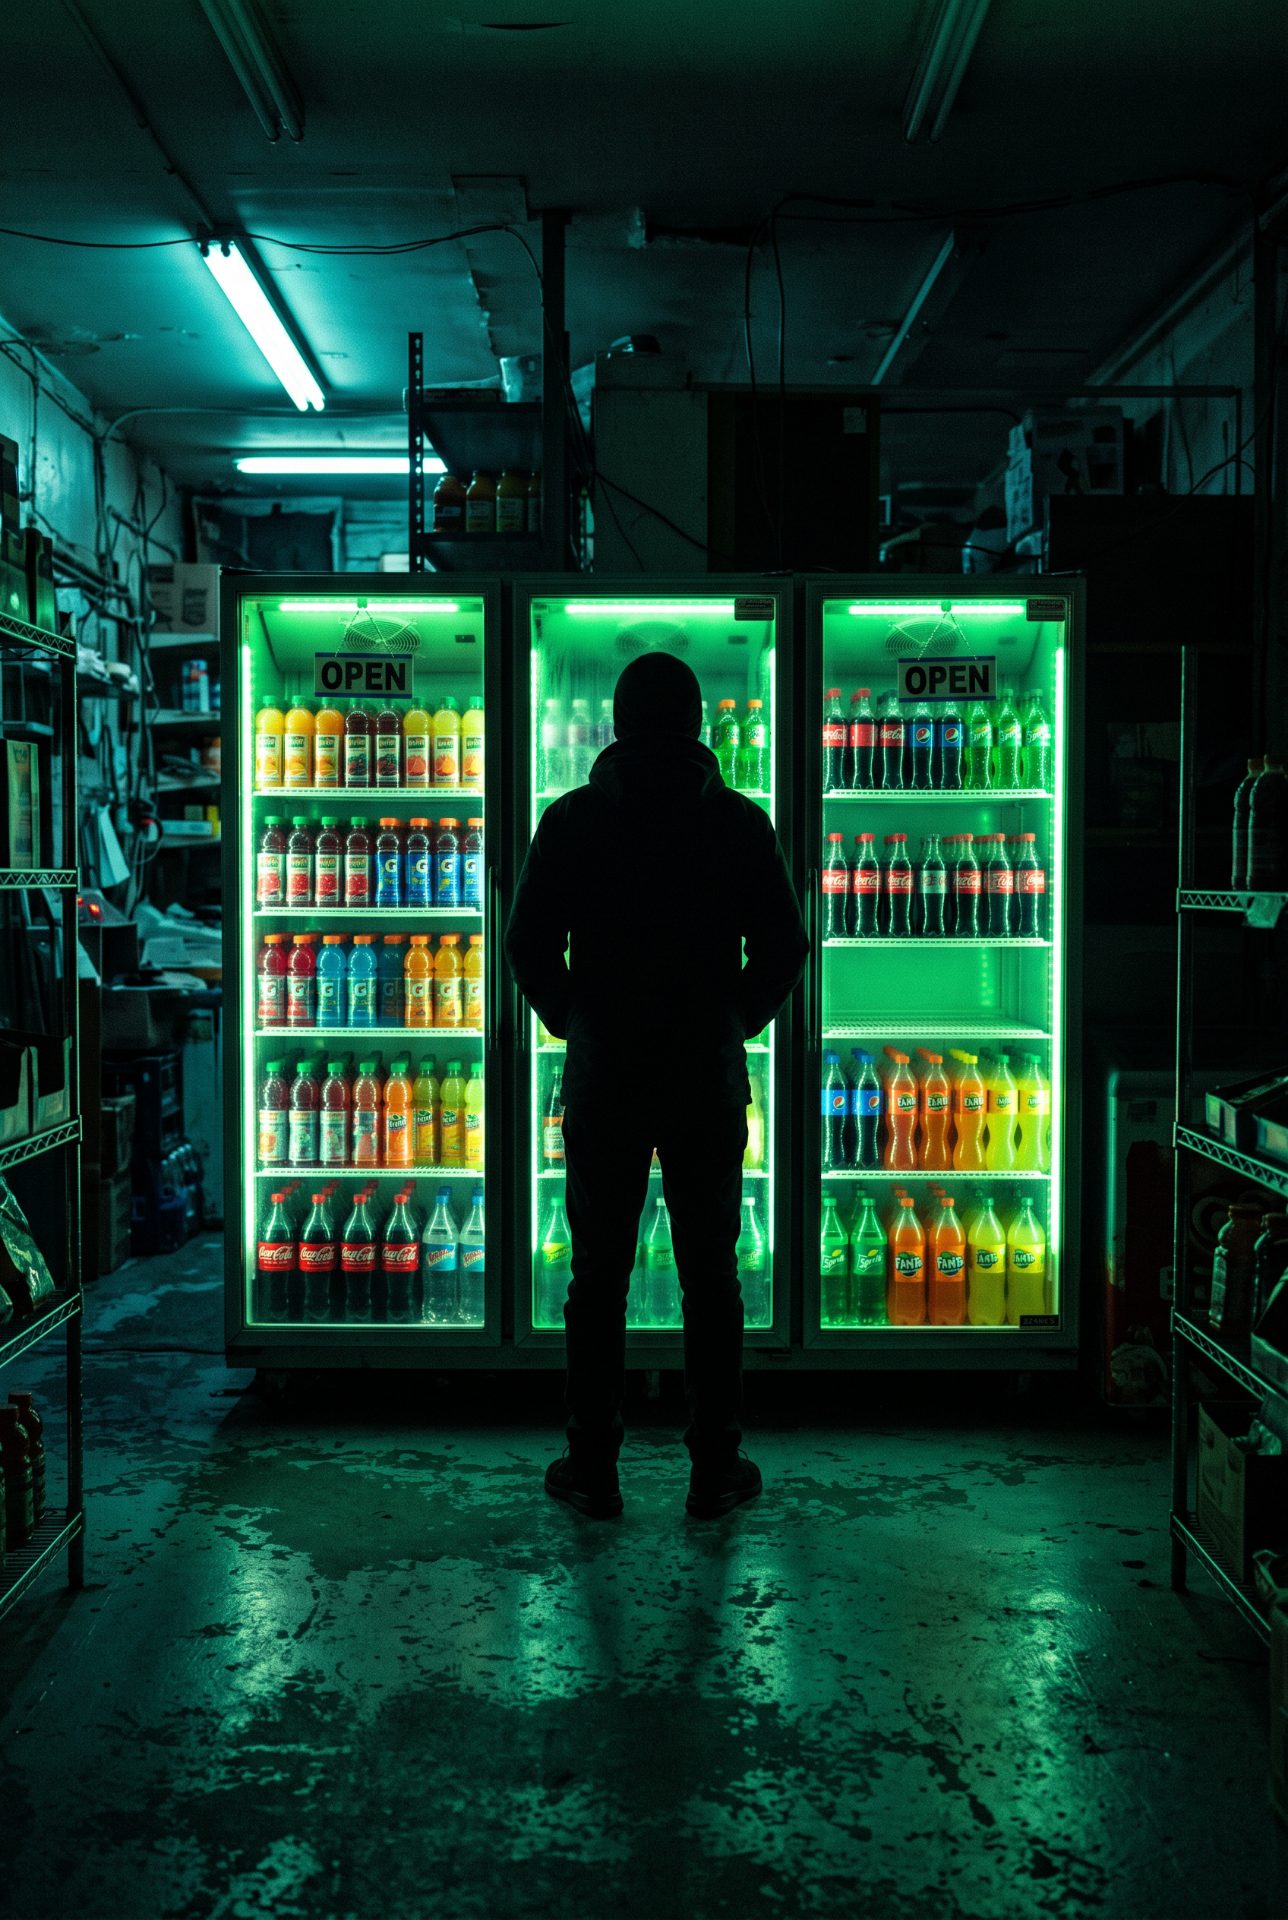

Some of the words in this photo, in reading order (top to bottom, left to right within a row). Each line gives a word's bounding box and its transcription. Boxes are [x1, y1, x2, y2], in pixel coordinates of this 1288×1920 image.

[321, 661, 406, 691] OPEN
[904, 665, 990, 695] OPEN
[322, 982, 334, 997] G
[354, 982, 367, 997] G
